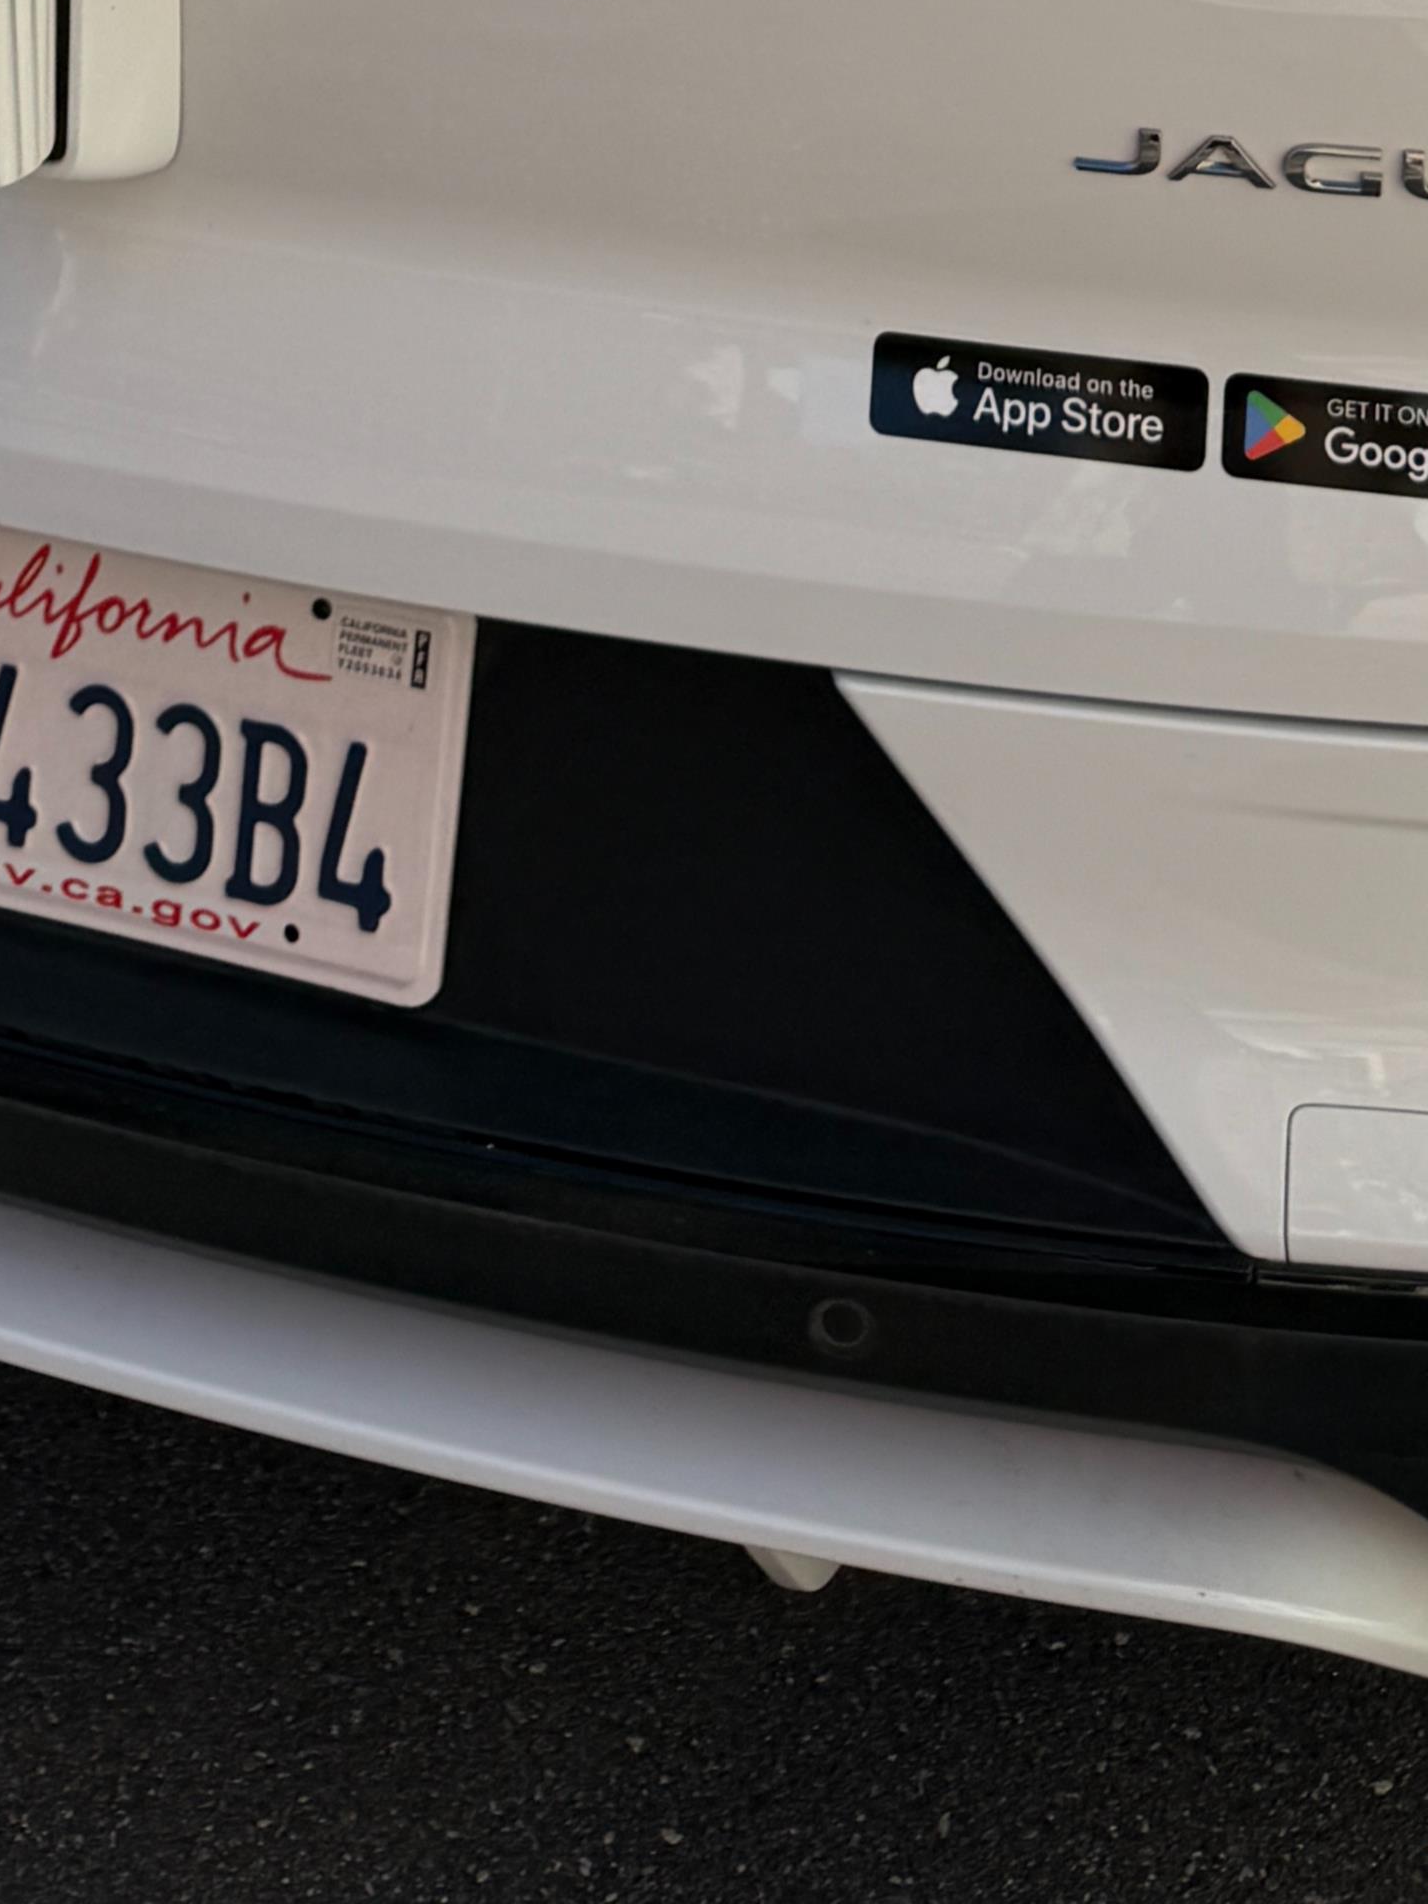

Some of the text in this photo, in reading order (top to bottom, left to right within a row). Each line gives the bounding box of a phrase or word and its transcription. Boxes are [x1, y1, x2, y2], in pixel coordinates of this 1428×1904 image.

[977, 361, 1154, 399] Download on the
[973, 387, 1164, 442] App Store
[1327, 398, 1369, 421] GET
[1375, 403, 1393, 422] IT
